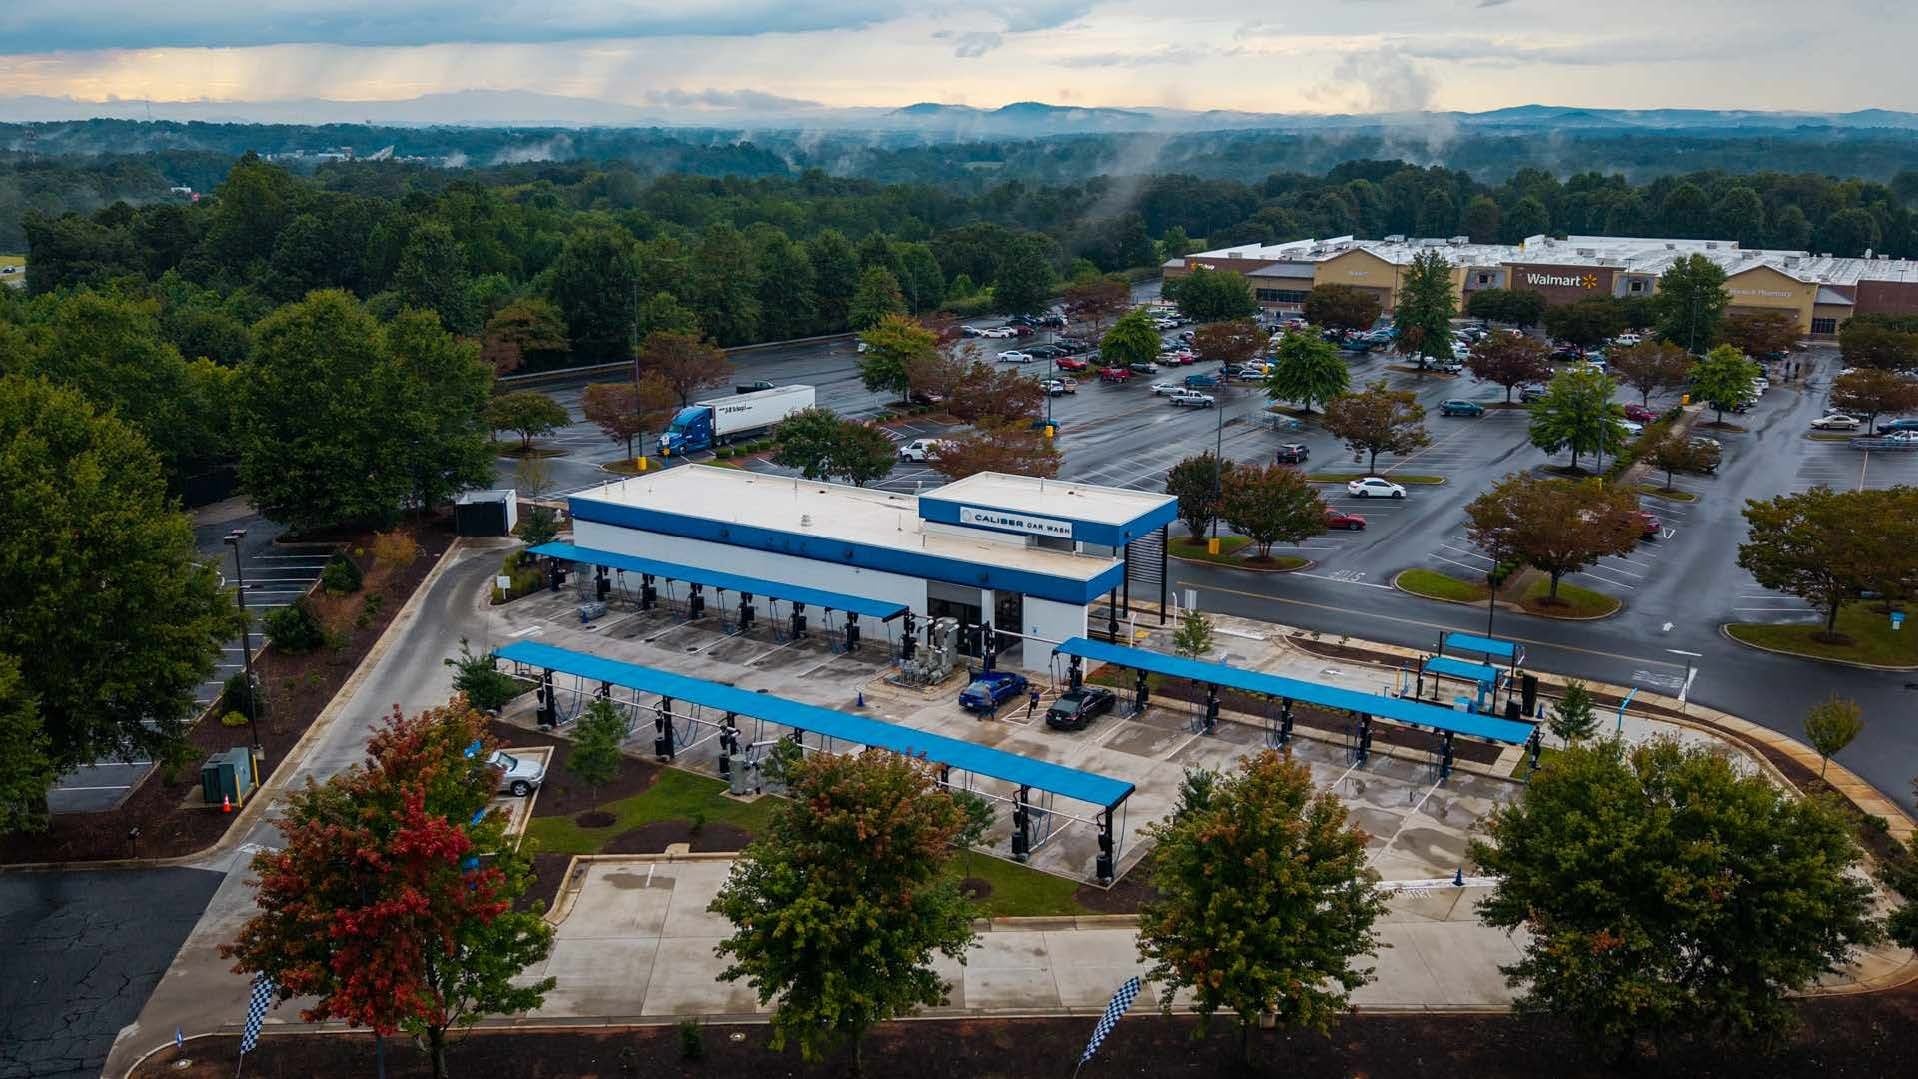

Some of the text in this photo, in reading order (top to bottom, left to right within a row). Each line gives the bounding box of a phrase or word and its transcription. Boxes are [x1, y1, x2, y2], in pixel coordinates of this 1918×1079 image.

[1527, 273, 1580, 287] Walmart
[974, 514, 1070, 534] CALIBER CAR WASH
